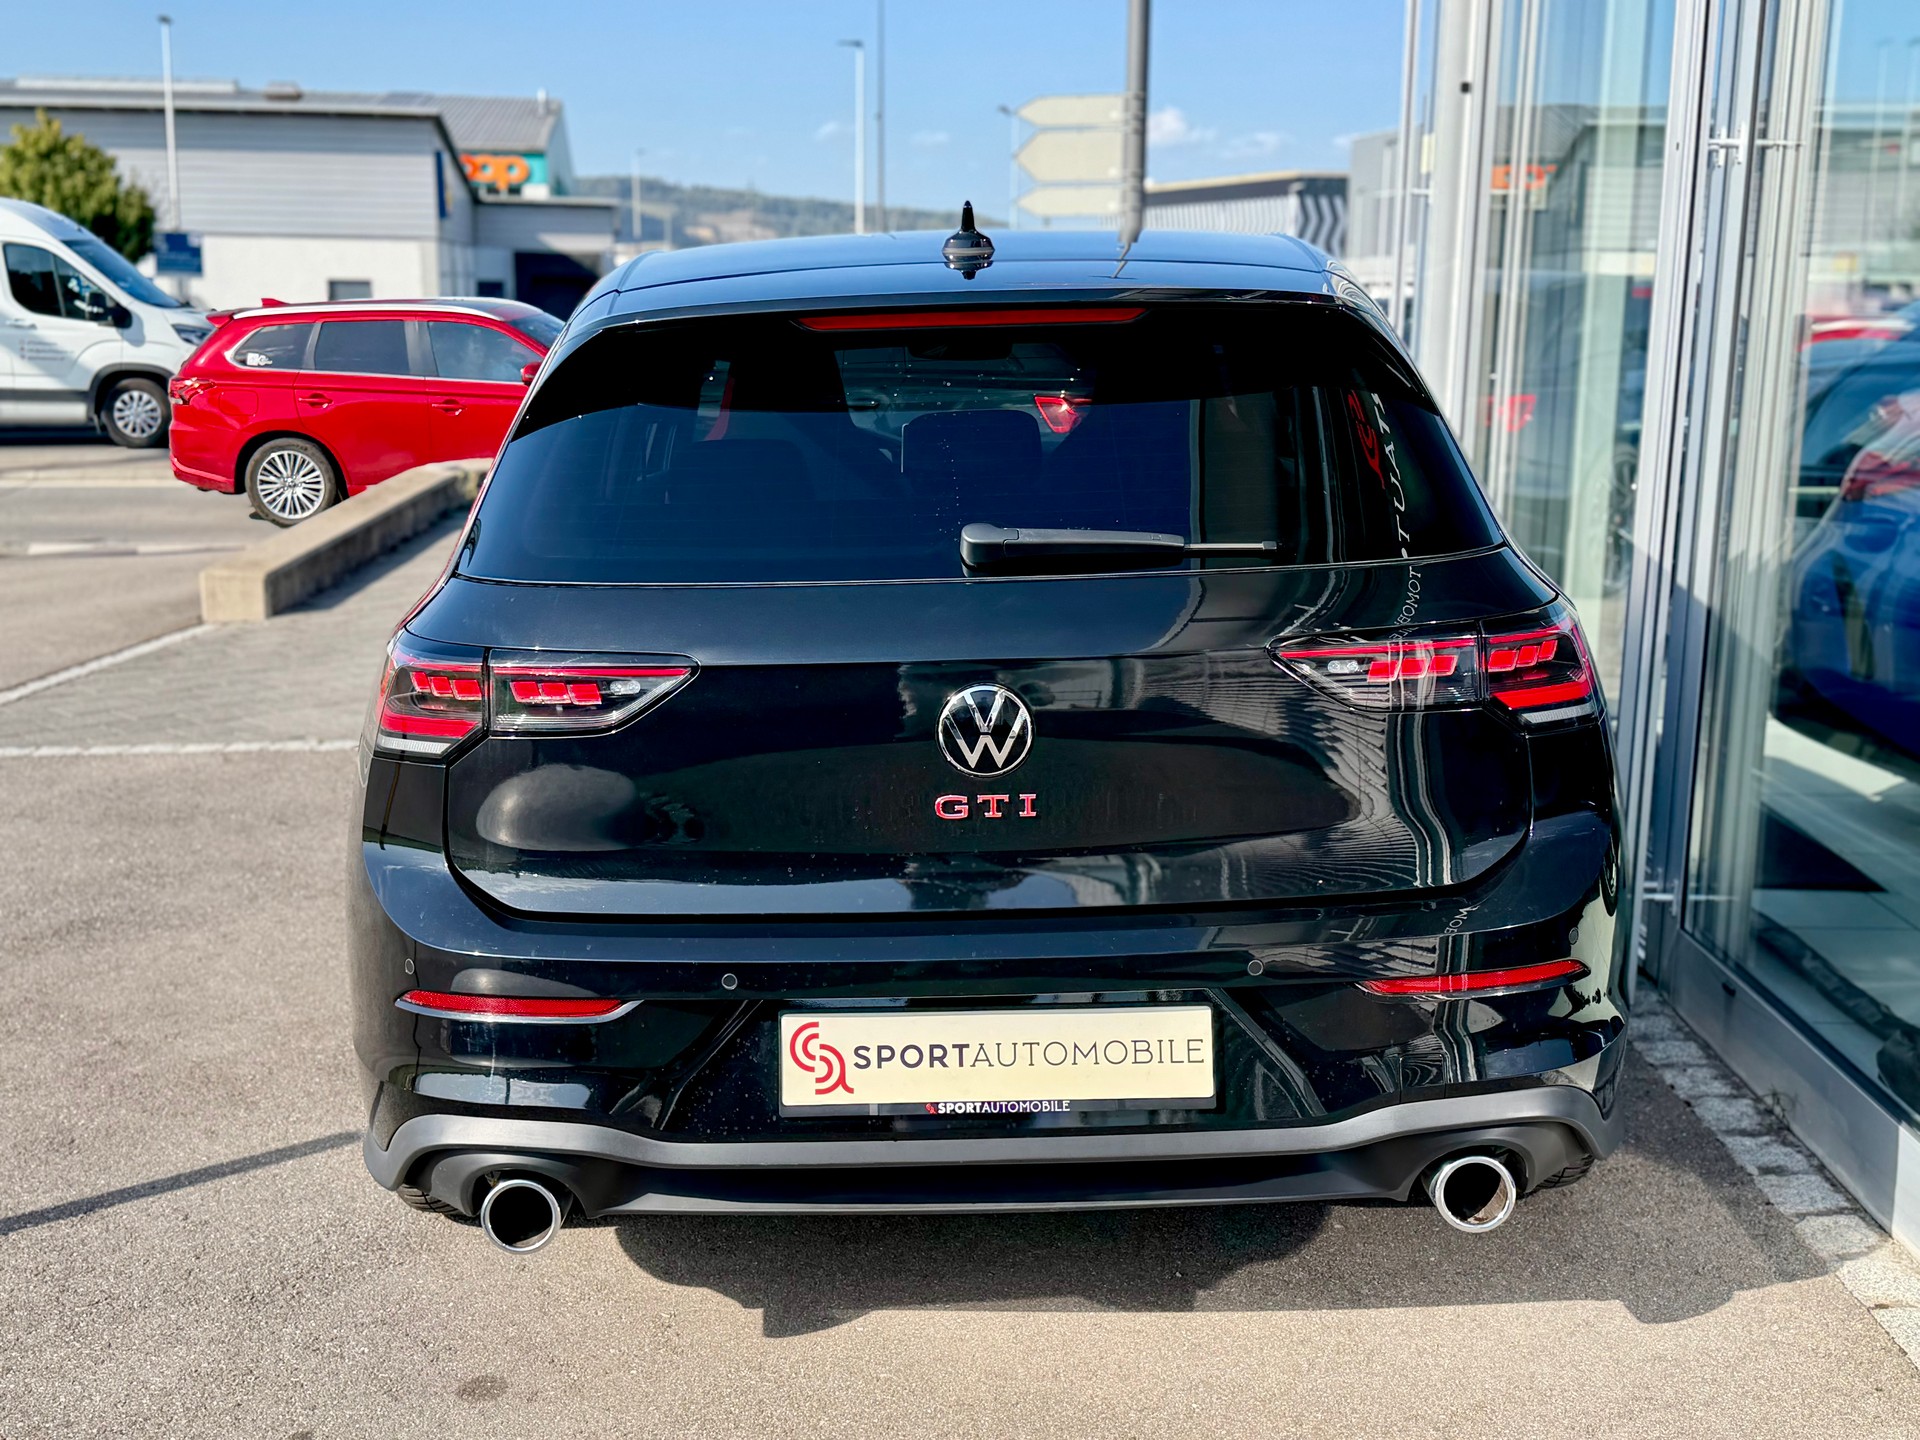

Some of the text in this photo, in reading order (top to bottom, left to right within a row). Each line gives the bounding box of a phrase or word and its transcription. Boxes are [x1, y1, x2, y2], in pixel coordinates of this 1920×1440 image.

[934, 793, 1038, 819] GTI
[853, 1039, 1205, 1069] SPORTAUTOMOBILE
[937, 1100, 1071, 1114] SPORTAUTOMOBILE
